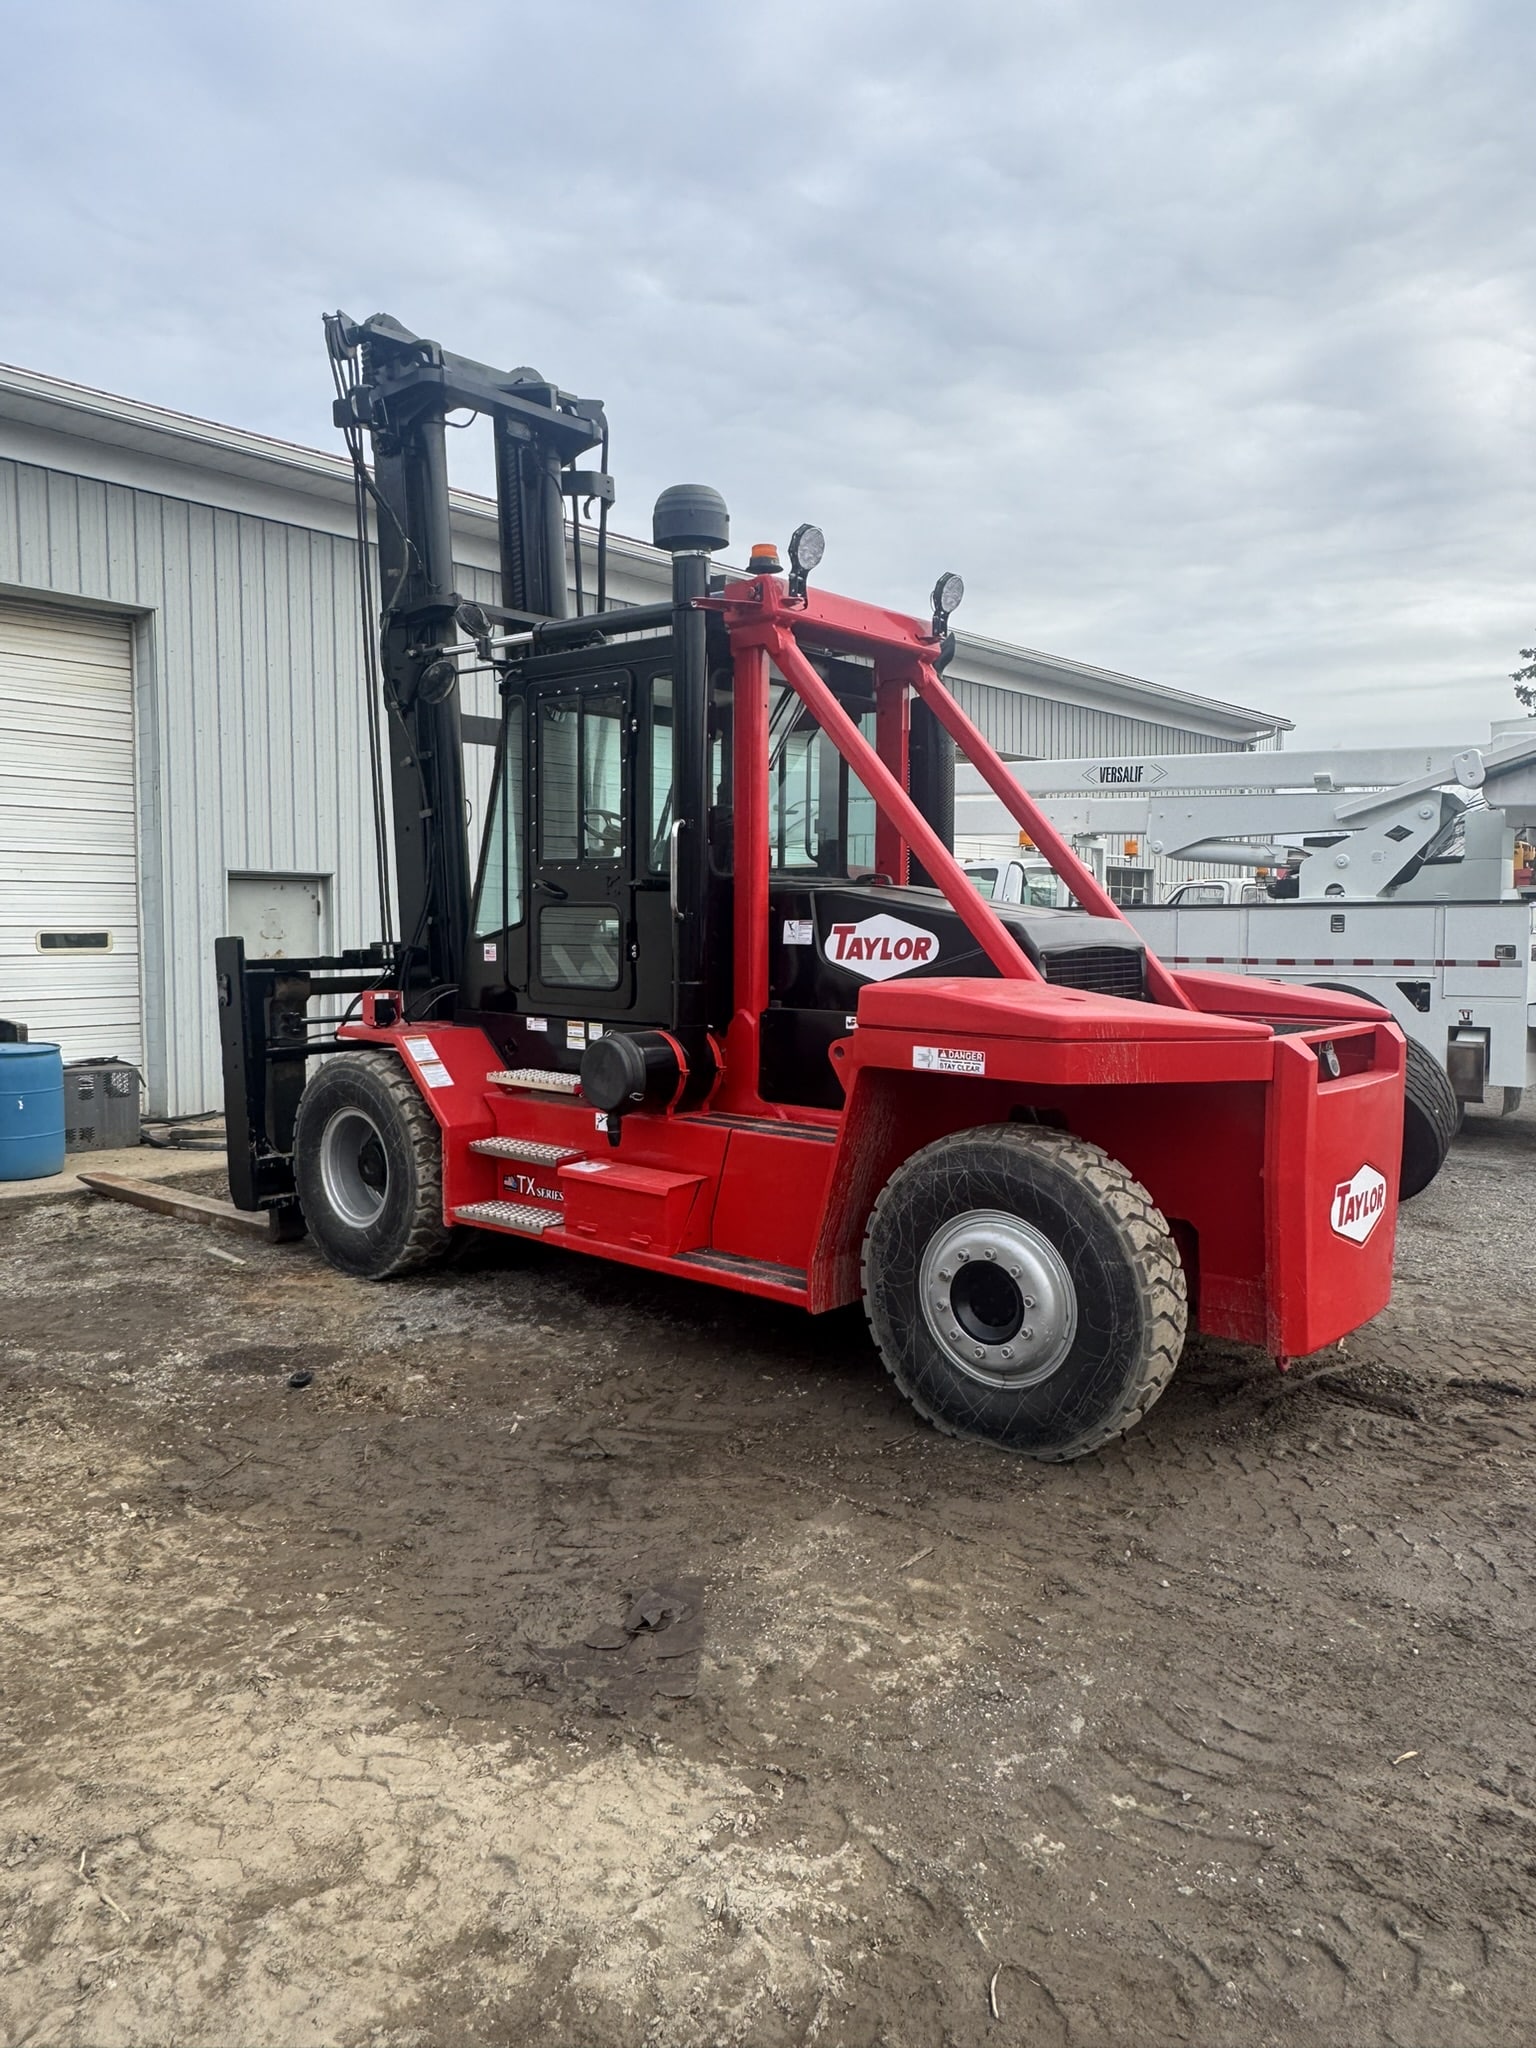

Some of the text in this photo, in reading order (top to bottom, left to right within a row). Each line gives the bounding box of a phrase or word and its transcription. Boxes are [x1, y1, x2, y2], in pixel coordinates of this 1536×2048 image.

[1099, 766, 1144, 783] VERSALIF
[833, 925, 932, 960] TAYLOR
[948, 1050, 983, 1061] DANGER
[940, 1062, 956, 1071] STAY
[956, 1064, 981, 1073] CLEAR
[516, 1174, 565, 1201] TX SERIES
[1337, 1183, 1384, 1228] TAYLOR
